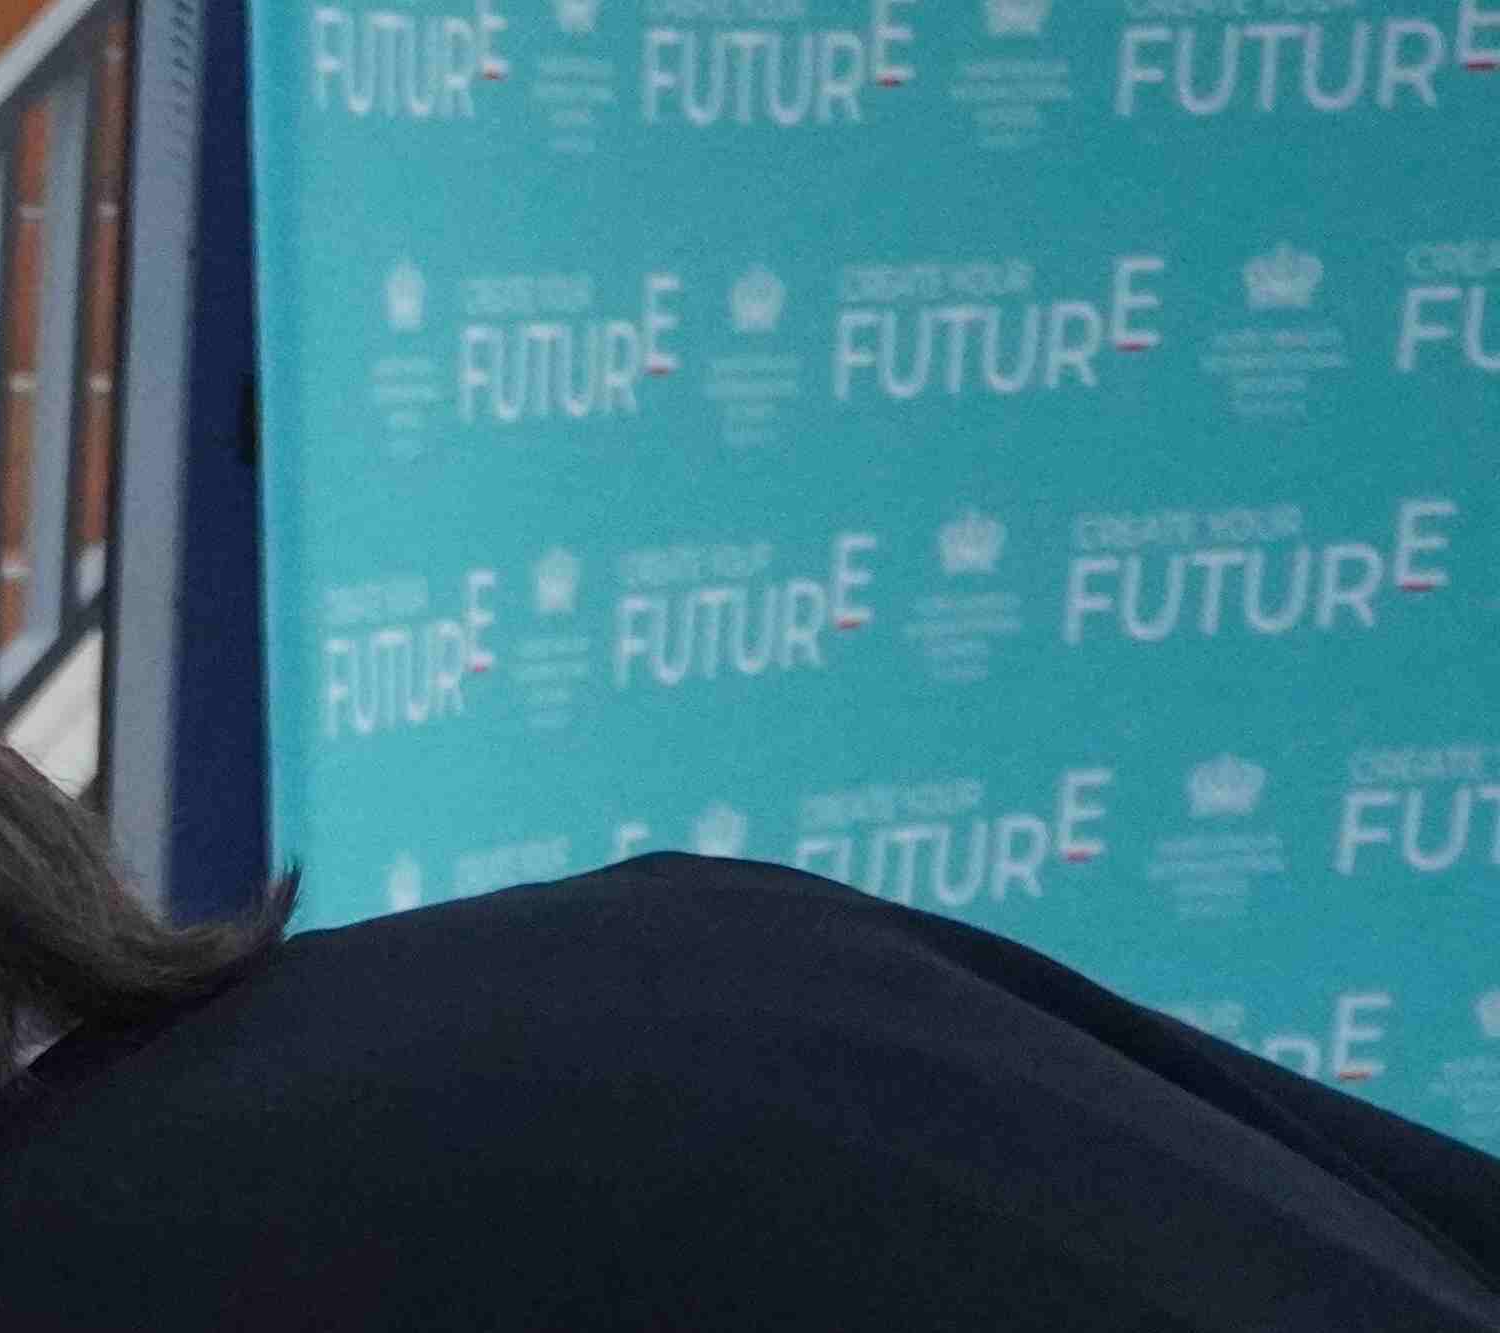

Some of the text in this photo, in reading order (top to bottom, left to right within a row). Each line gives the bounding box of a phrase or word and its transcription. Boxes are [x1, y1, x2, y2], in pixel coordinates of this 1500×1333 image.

[458, 272, 680, 421] FUTURE
[834, 256, 1164, 399] FUTURE
[614, 535, 876, 689] FUTURE
[1063, 498, 1457, 645] FUTURE
[323, 568, 496, 737] FUTURE
